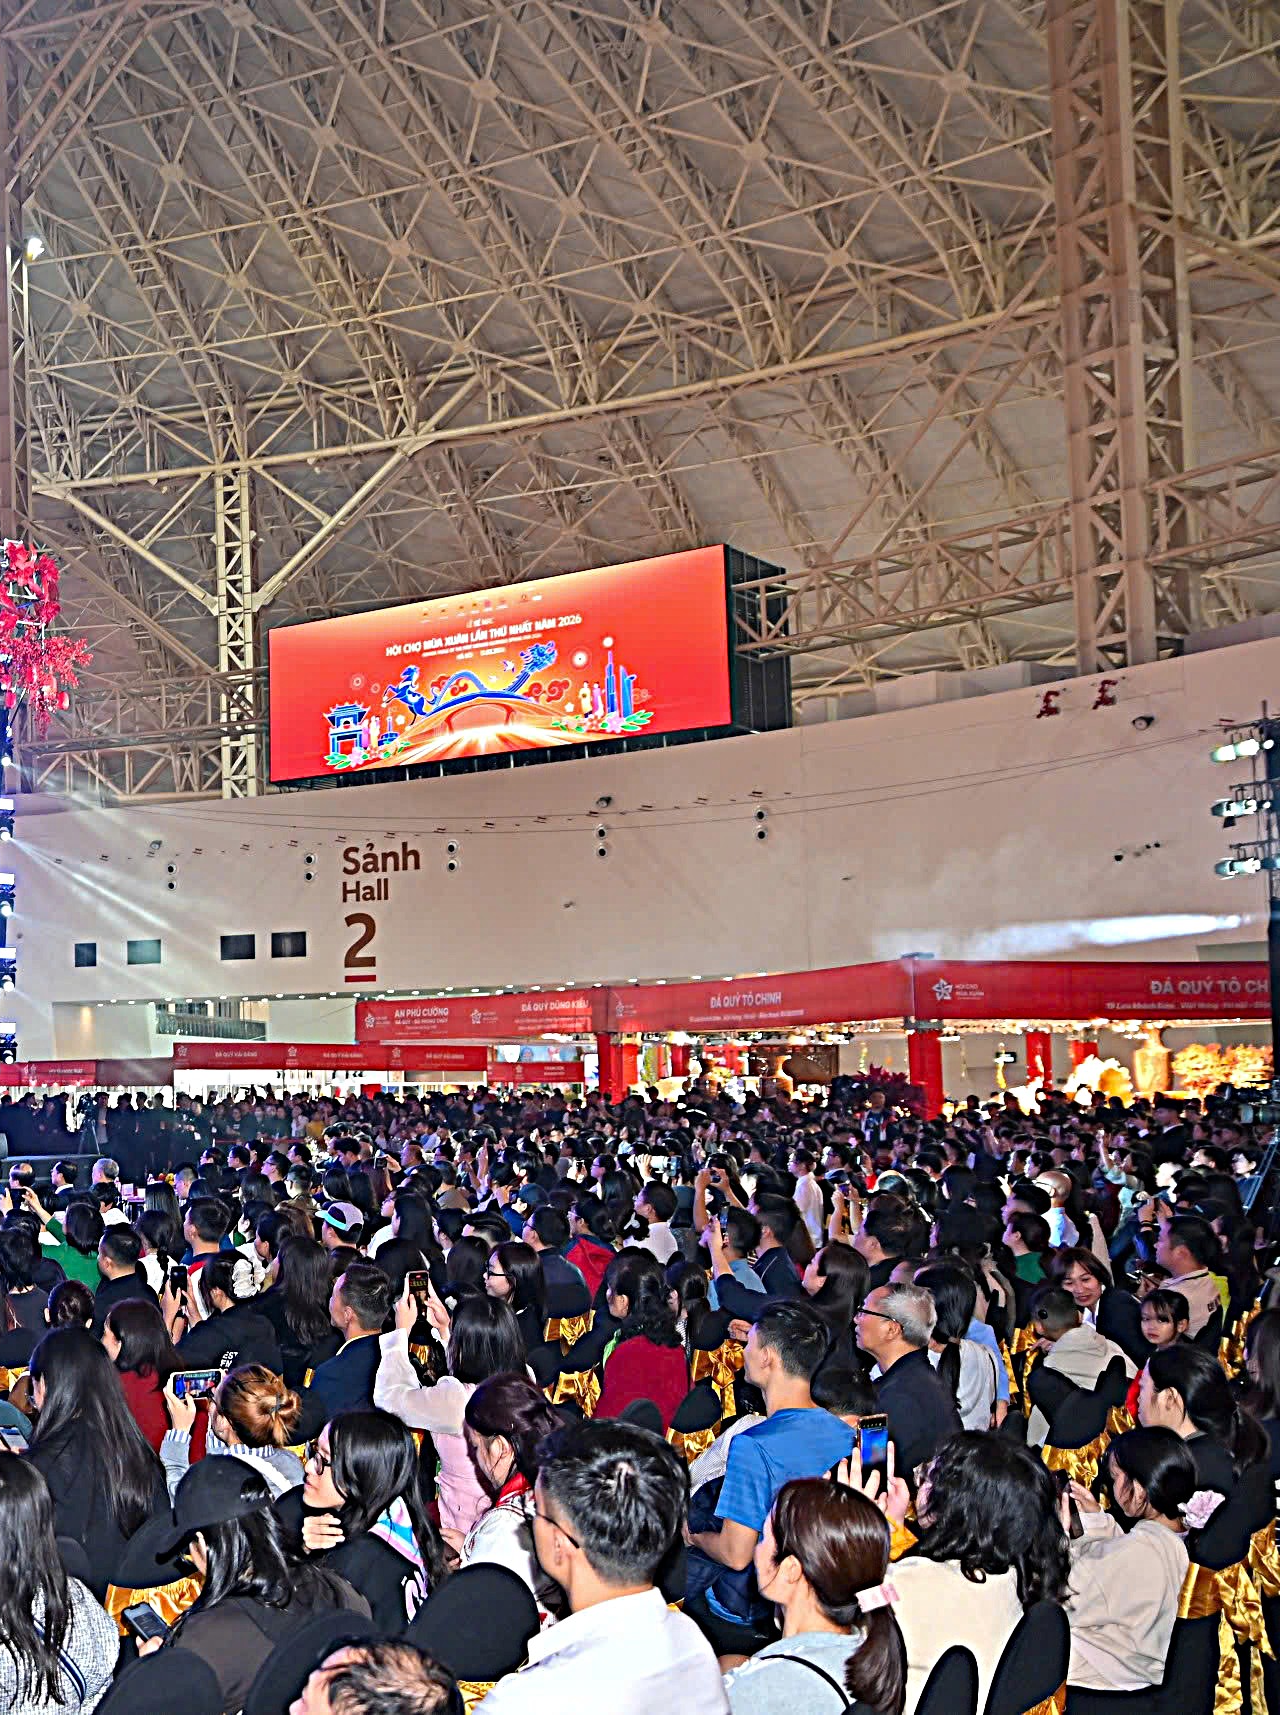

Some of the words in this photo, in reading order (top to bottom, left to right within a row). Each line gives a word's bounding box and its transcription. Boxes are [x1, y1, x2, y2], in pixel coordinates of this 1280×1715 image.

[385, 644, 402, 657] HỘI
[403, 641, 422, 654] CHỢ
[557, 613, 582, 627] 2026
[342, 841, 421, 875] Sảnh
[342, 878, 389, 903] Hall
[344, 912, 376, 968] 2
[1178, 976, 1213, 994] QUÝ
[394, 1009, 405, 1018] AN
[406, 1006, 422, 1017] PHÚ
[723, 992, 740, 1008] QUÝ
